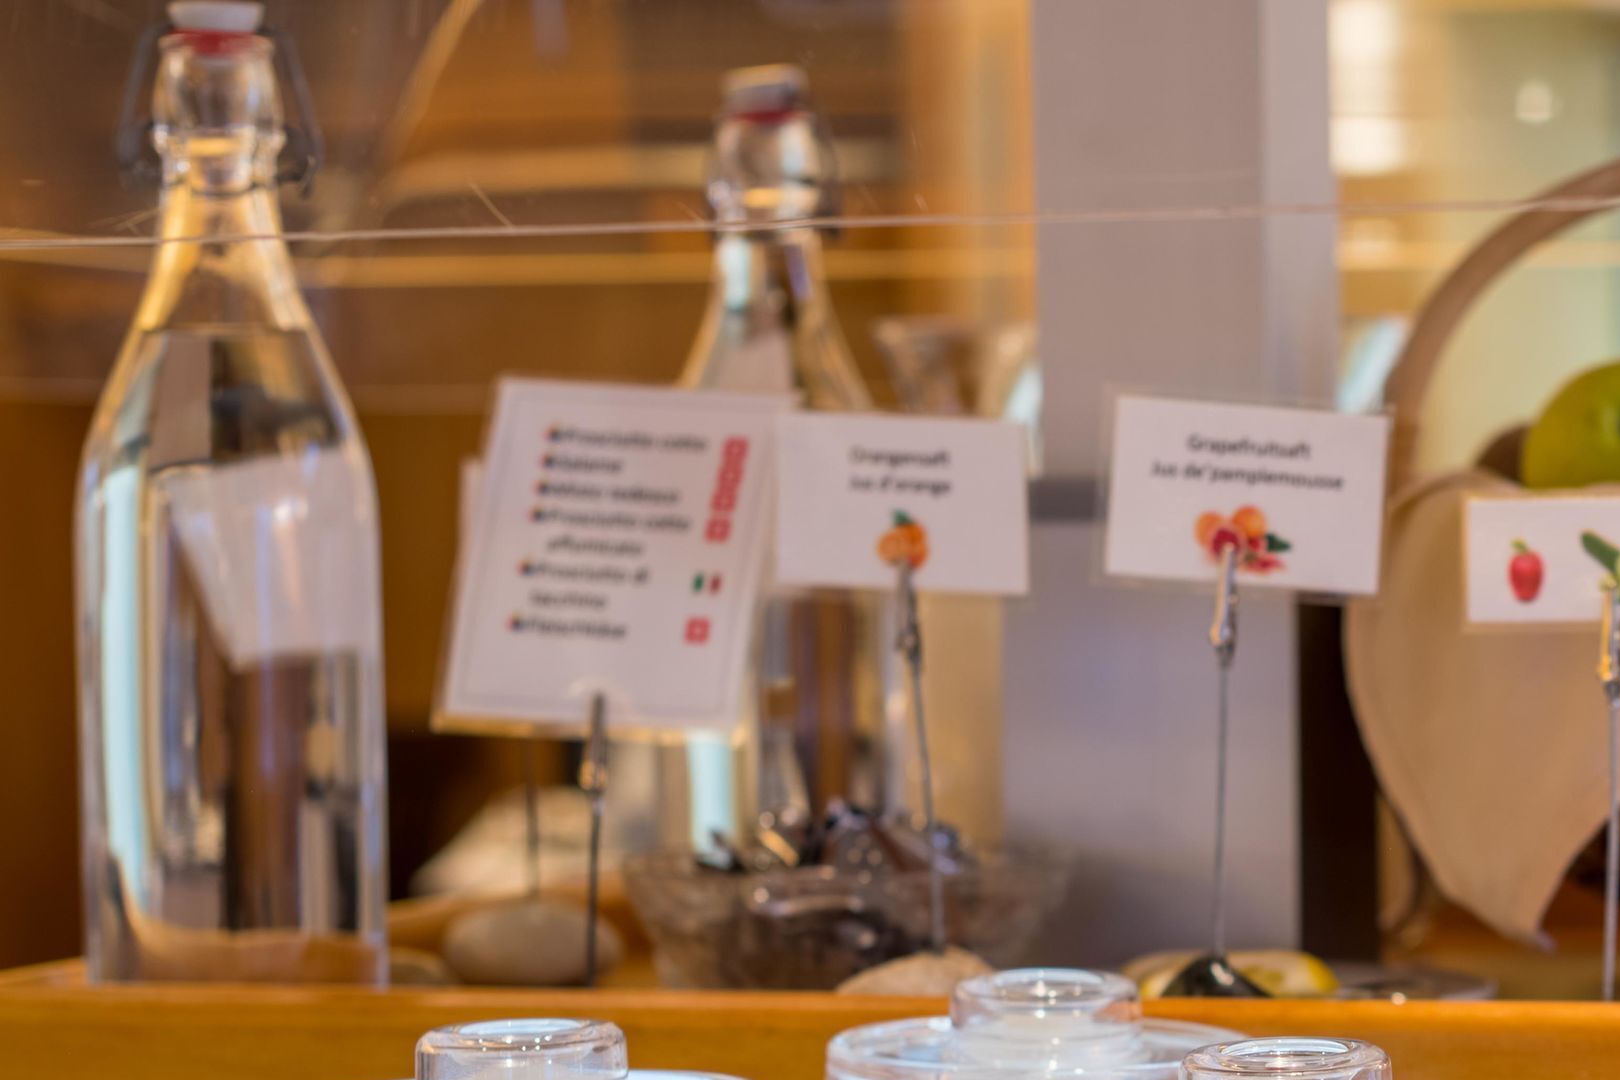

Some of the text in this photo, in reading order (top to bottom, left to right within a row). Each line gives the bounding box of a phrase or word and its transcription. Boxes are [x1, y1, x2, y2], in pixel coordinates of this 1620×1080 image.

[1187, 432, 1312, 460] Grapefruitsaft
[1150, 461, 1177, 479] Jus
[848, 474, 872, 492] Jus
